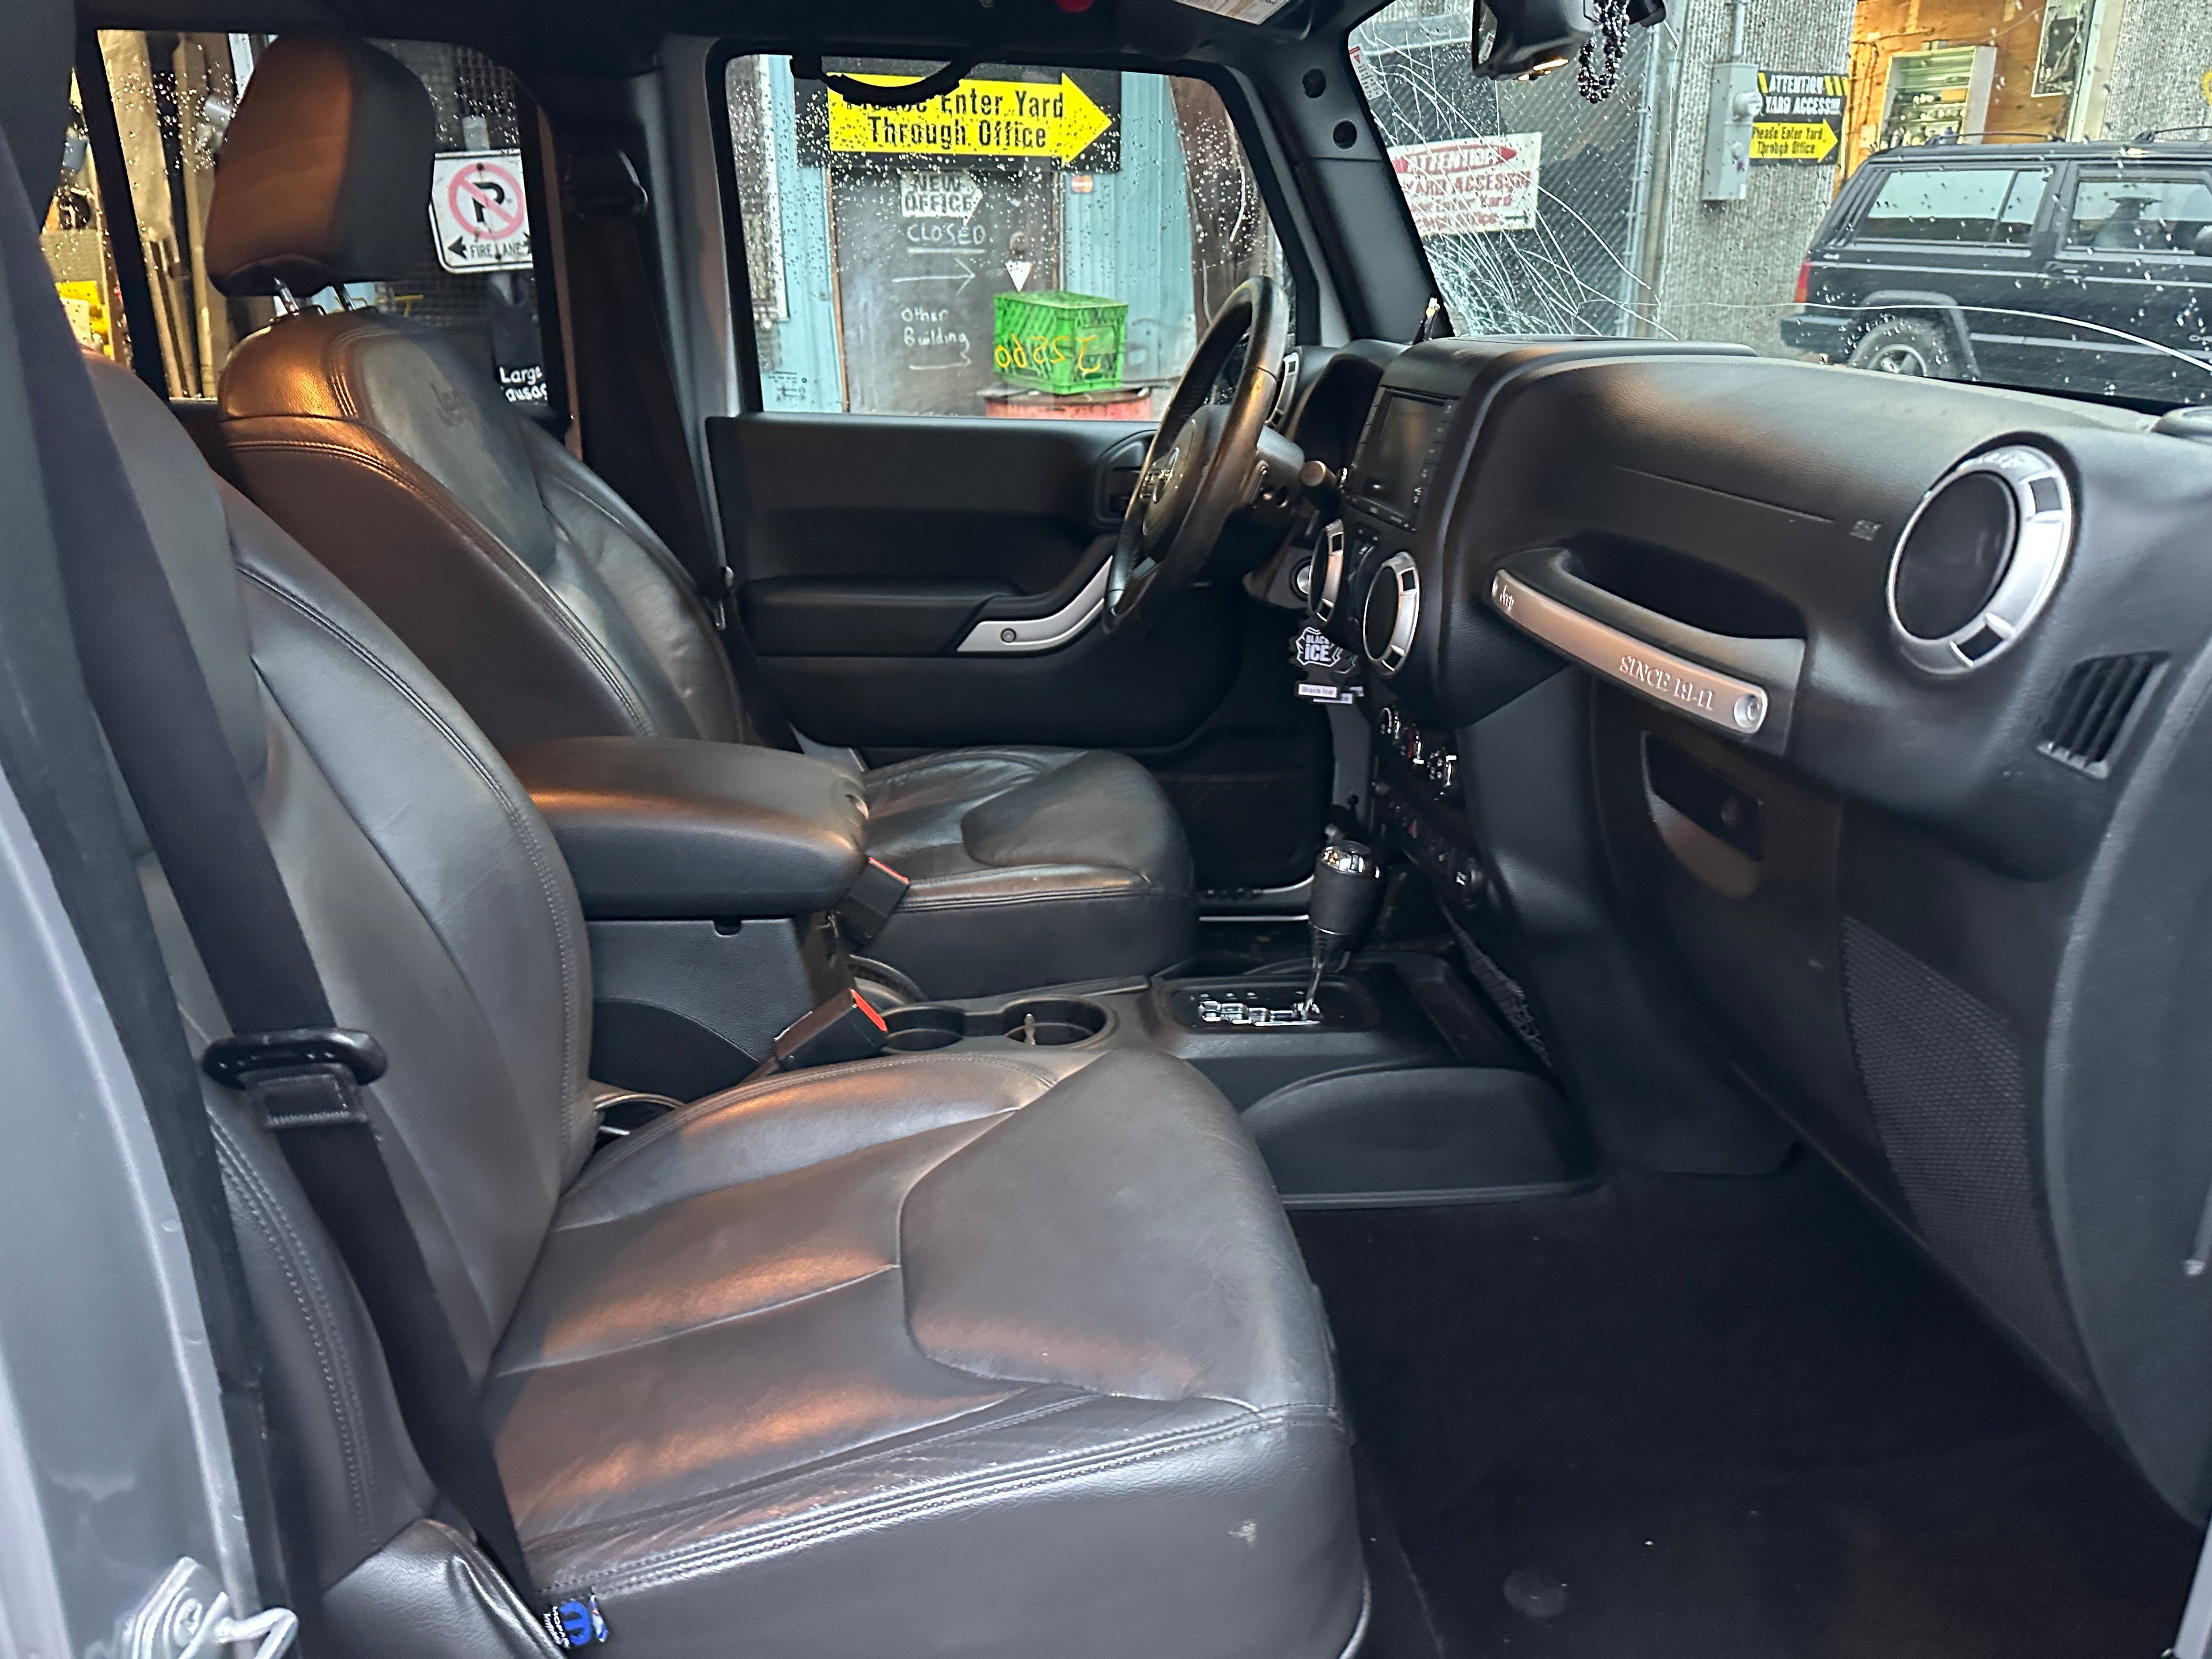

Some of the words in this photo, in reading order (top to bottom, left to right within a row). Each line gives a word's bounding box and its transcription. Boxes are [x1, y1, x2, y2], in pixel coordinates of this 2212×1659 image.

[1768, 74, 1824, 94] ATTENTION
[941, 88, 1003, 115] Enter
[1015, 89, 1063, 118] Yard
[1765, 96, 1791, 114] YARD
[868, 116, 967, 149] Through
[979, 119, 1046, 148] Office
[905, 192, 972, 213] OFFICE
[907, 223, 986, 245] CLOSED
[469, 244, 493, 258] FIRE
[900, 307, 949, 322] Other
[904, 325, 969, 353] Building
[1305, 634, 1330, 645] BLACK
[1619, 656, 1671, 692] SINCE
